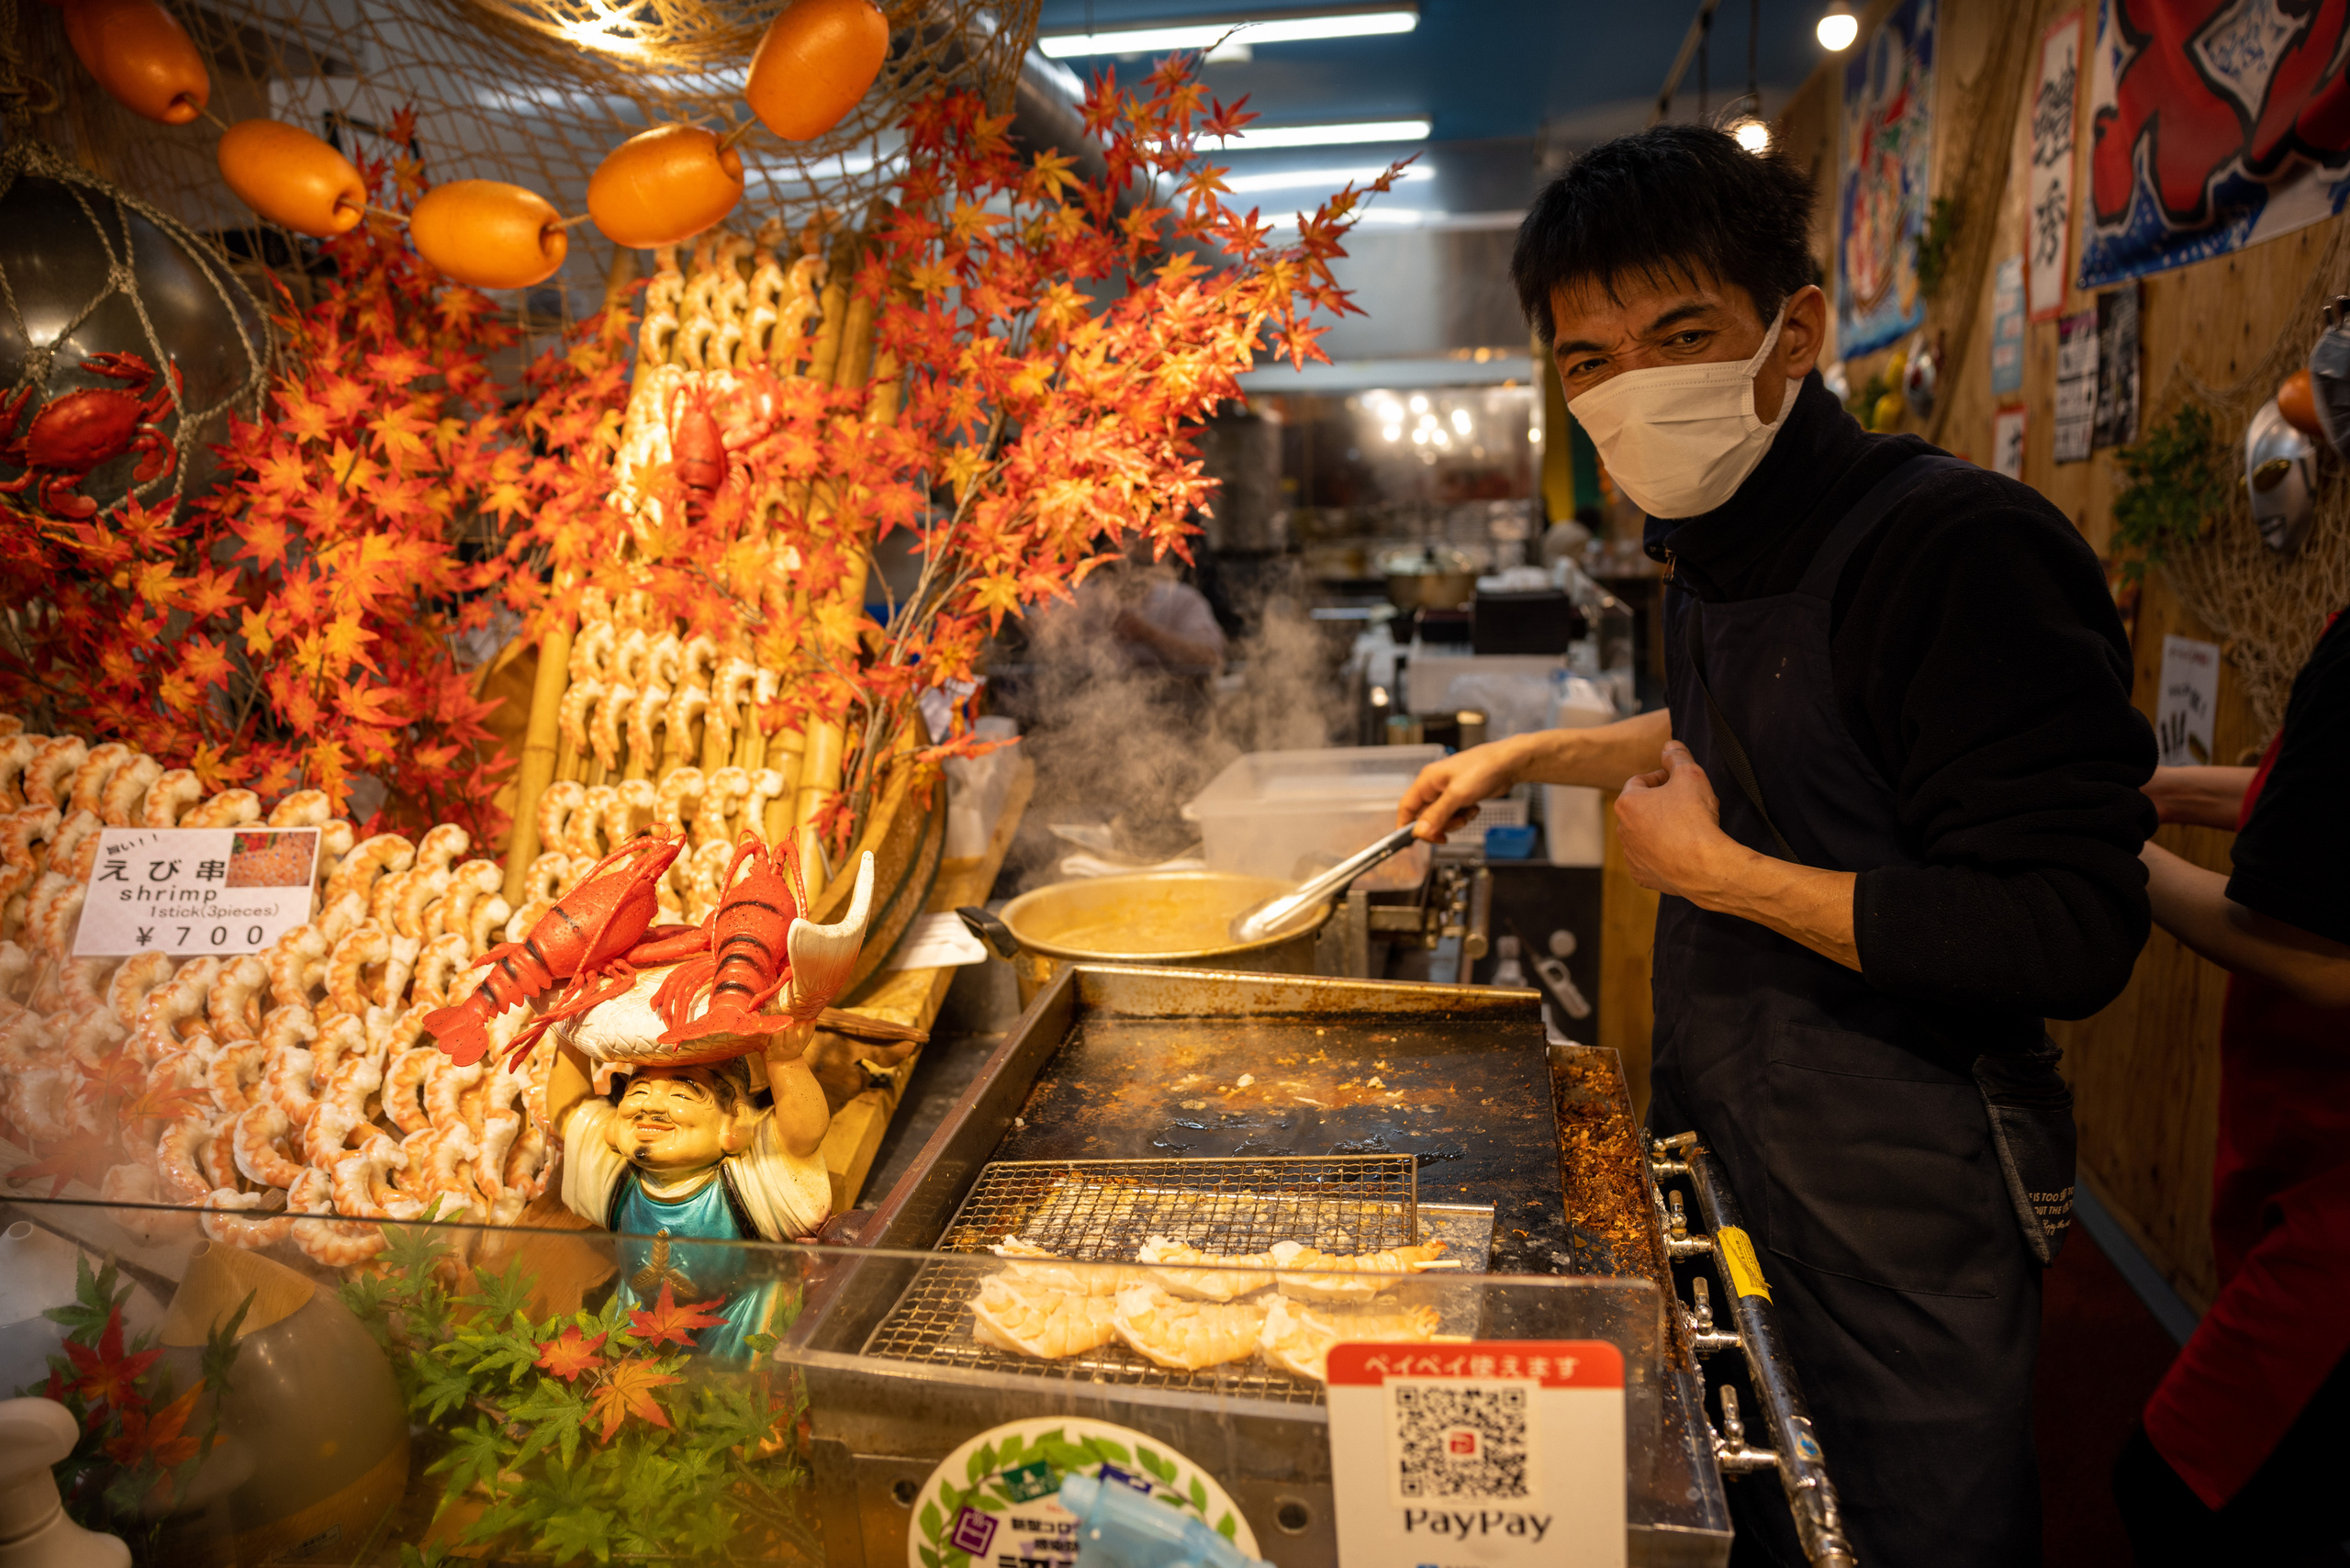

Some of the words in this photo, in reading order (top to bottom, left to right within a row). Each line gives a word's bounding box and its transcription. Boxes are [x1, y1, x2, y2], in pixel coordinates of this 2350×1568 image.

[98, 859, 226, 882] えび串
[119, 885, 218, 904] shrimp
[2042, 1193, 2059, 1202] TOO
[1364, 1353, 1580, 1381] ペイペイ使えます
[1404, 1508, 1552, 1544] PayPay
